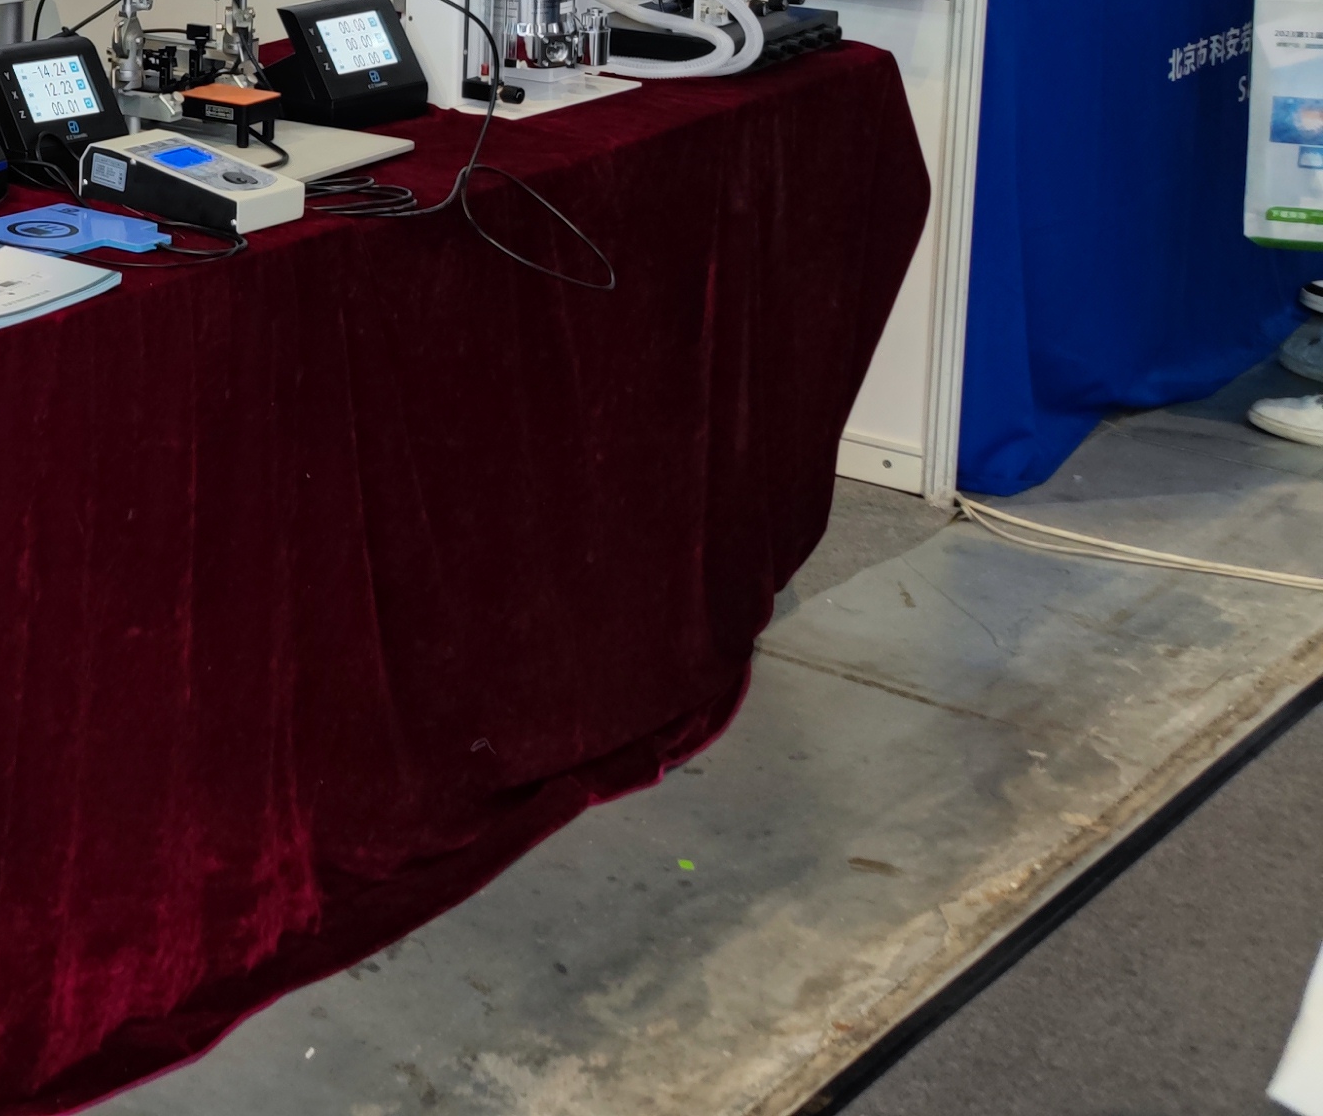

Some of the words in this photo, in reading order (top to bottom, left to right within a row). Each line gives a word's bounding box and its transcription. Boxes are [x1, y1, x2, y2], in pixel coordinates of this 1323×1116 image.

[338, 18, 366, 34] 00.00
[345, 34, 373, 50] 00.00
[353, 51, 381, 67] 00.00
[32, 62, 67, 79] -14.24
[44, 80, 74, 97] 12.23
[51, 98, 81, 116] 00.01
